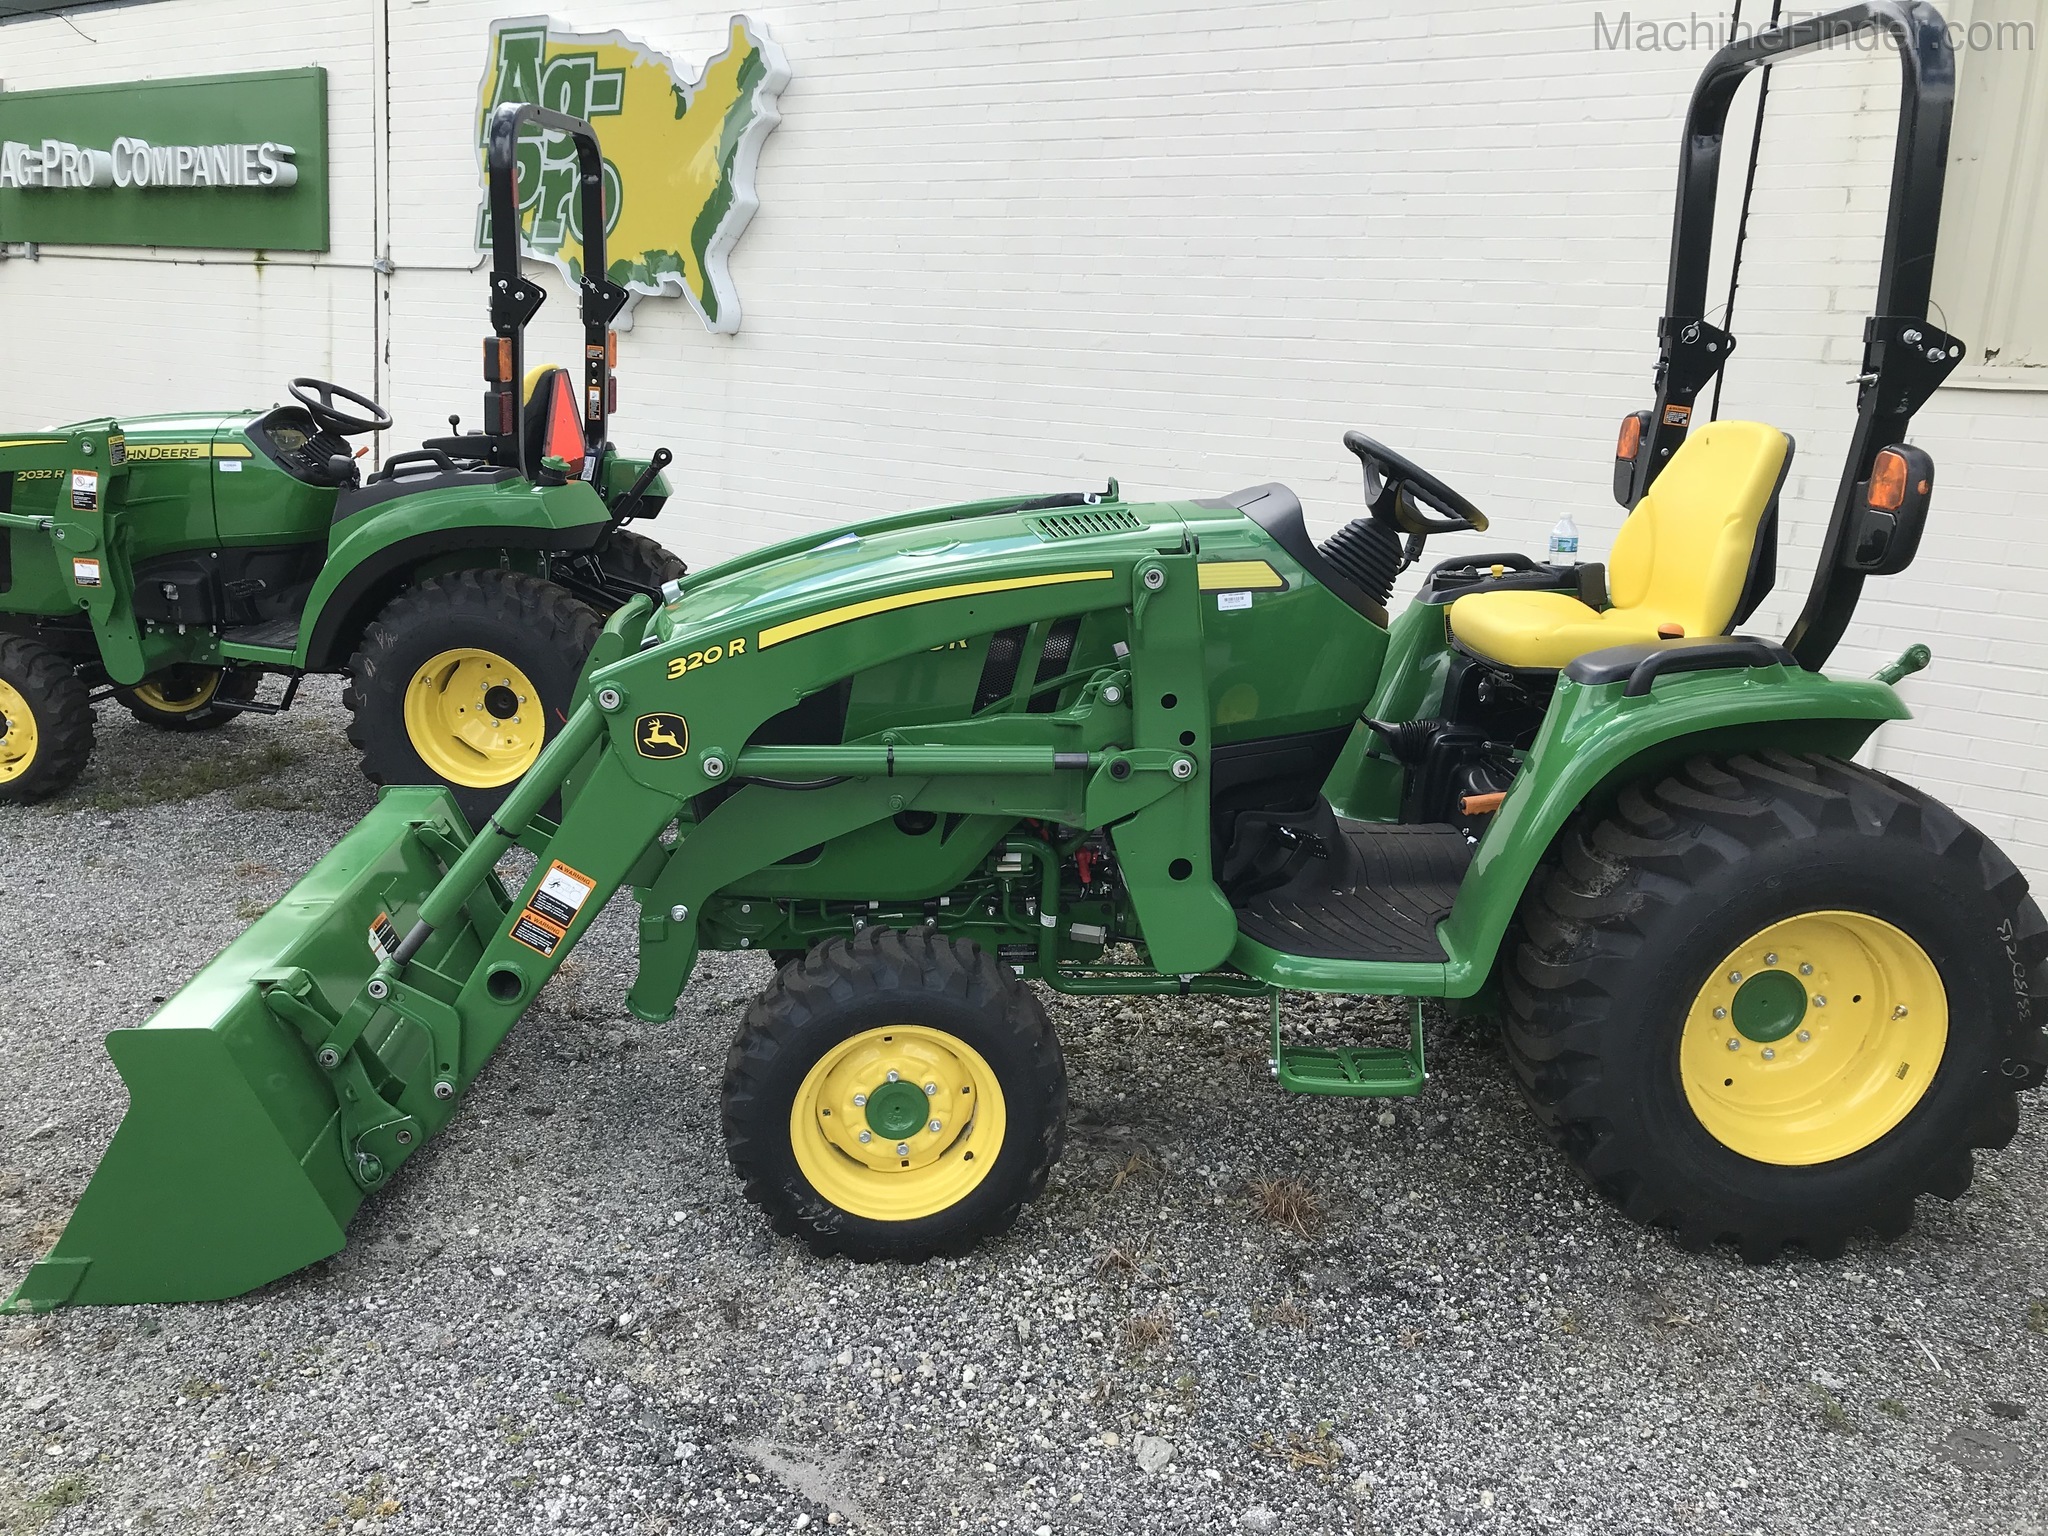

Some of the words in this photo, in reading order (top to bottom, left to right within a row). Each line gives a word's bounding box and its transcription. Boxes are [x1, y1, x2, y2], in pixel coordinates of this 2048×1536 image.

[126, 449, 147, 459] HN
[149, 447, 199, 458] DEERE
[17, 469, 52, 482] 2032
[54, 469, 65, 478] R
[667, 645, 723, 680] 320
[728, 637, 746, 658] R
[563, 865, 591, 885] WARNING
[533, 916, 560, 935] WARNING
